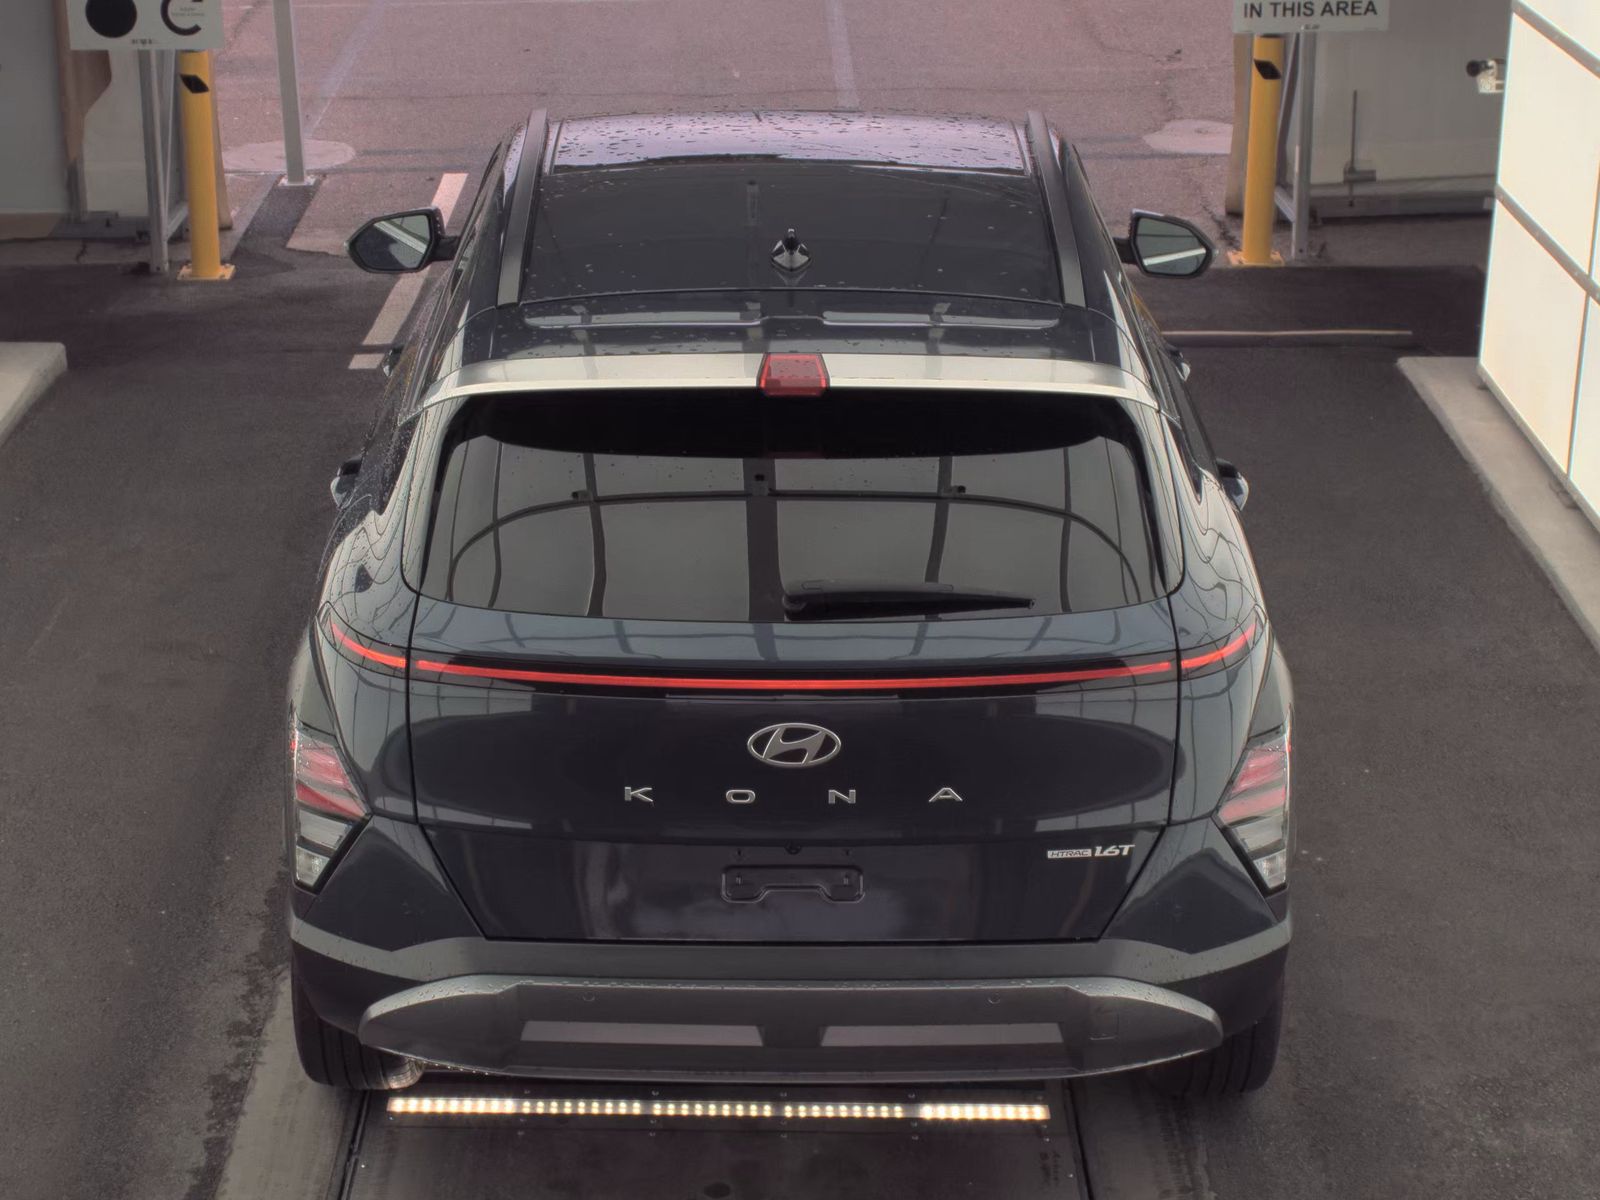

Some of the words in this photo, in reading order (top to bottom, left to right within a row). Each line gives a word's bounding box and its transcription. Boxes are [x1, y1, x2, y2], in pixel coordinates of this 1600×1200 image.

[1243, 2, 1263, 18] IN
[1271, 2, 1315, 18] THIS
[1320, 0, 1378, 17] AREA
[624, 786, 963, 804] KONA
